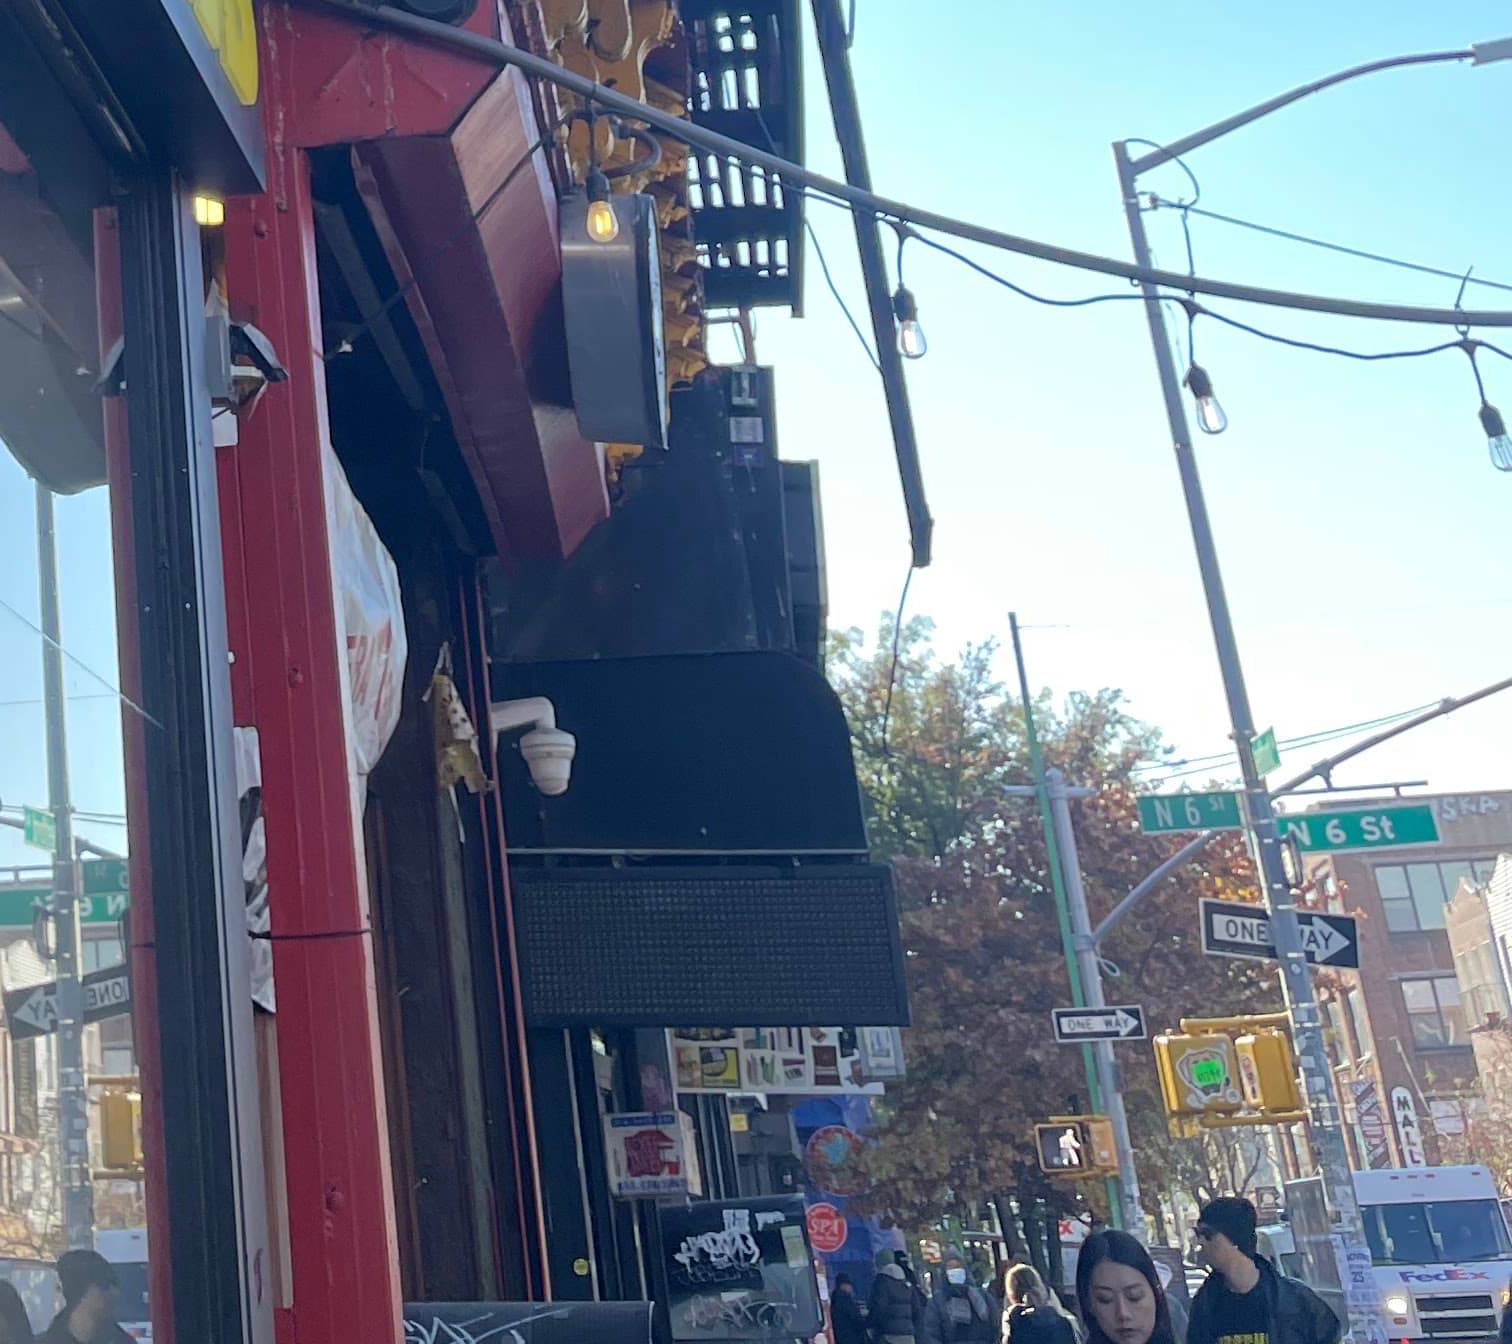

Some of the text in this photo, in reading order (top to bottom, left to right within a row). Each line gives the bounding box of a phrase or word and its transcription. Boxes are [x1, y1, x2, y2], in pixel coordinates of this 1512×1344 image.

[1153, 799, 1174, 828] N
[1184, 797, 1201, 826] 6
[1289, 815, 1395, 846] N 6 St
[1225, 919, 1269, 943] ONE
[1067, 1016, 1130, 1031] ONE WAY
[1396, 1095, 1421, 1164] MALL
[1399, 1268, 1491, 1284] FedEx
